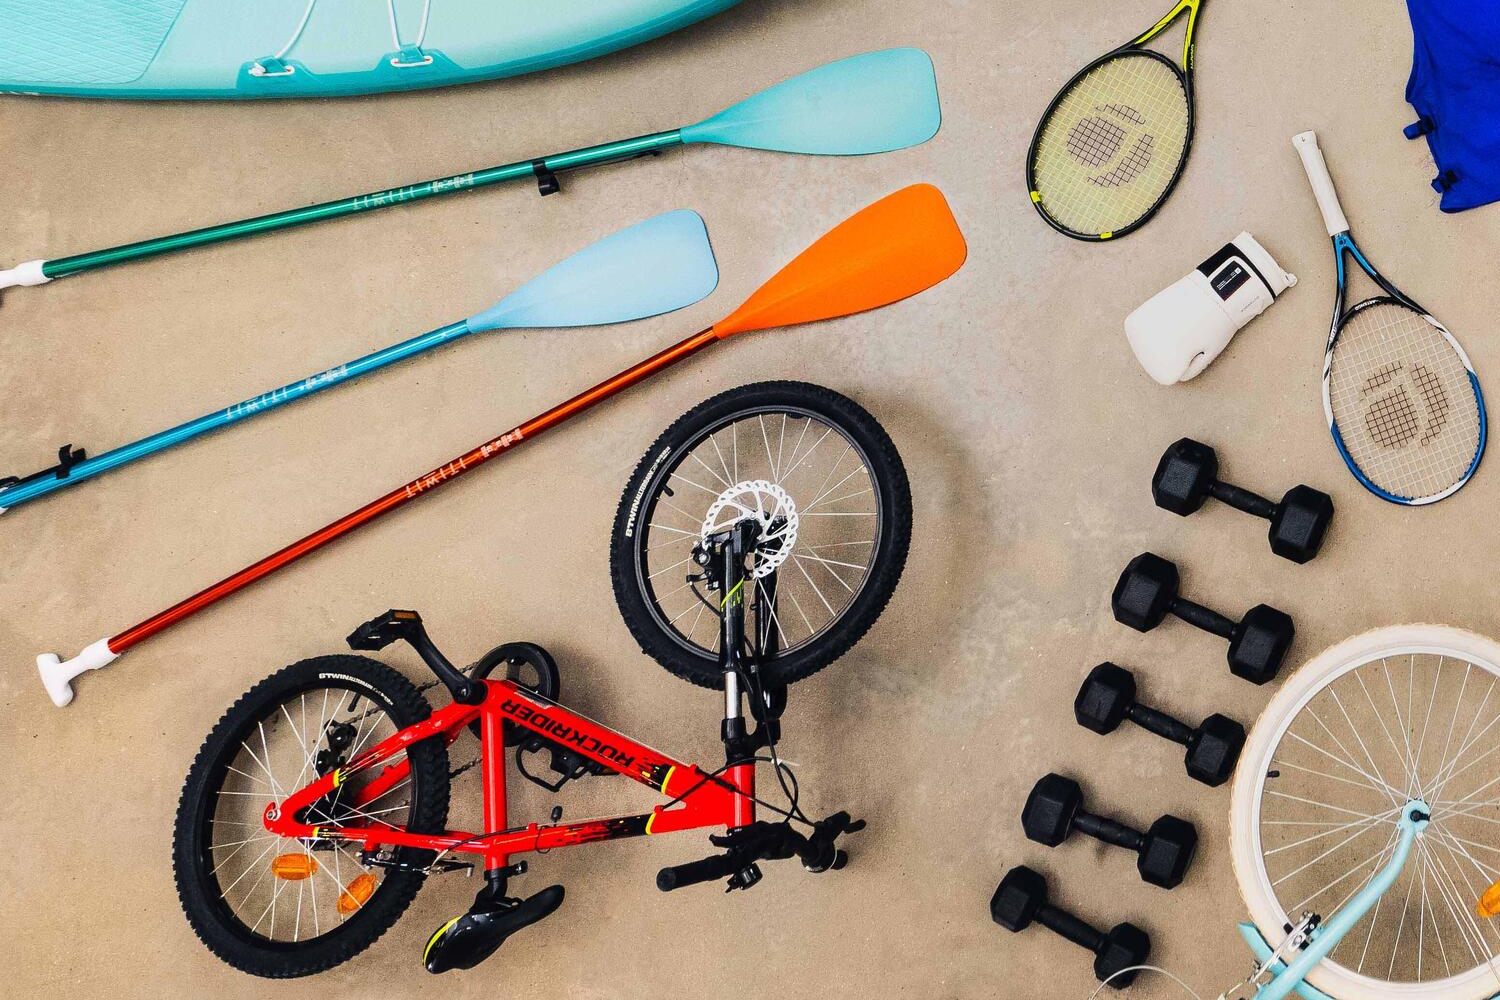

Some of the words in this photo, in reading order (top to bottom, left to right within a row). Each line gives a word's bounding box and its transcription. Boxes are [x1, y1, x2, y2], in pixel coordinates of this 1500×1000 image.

[352, 186, 415, 210] ITIWIT
[226, 386, 288, 419] ITIWIT
[406, 457, 467, 498] ITIWIT
[625, 497, 641, 538] BTWIN
[318, 672, 350, 681] BTWIN
[500, 698, 637, 768] ROCKRIDER
